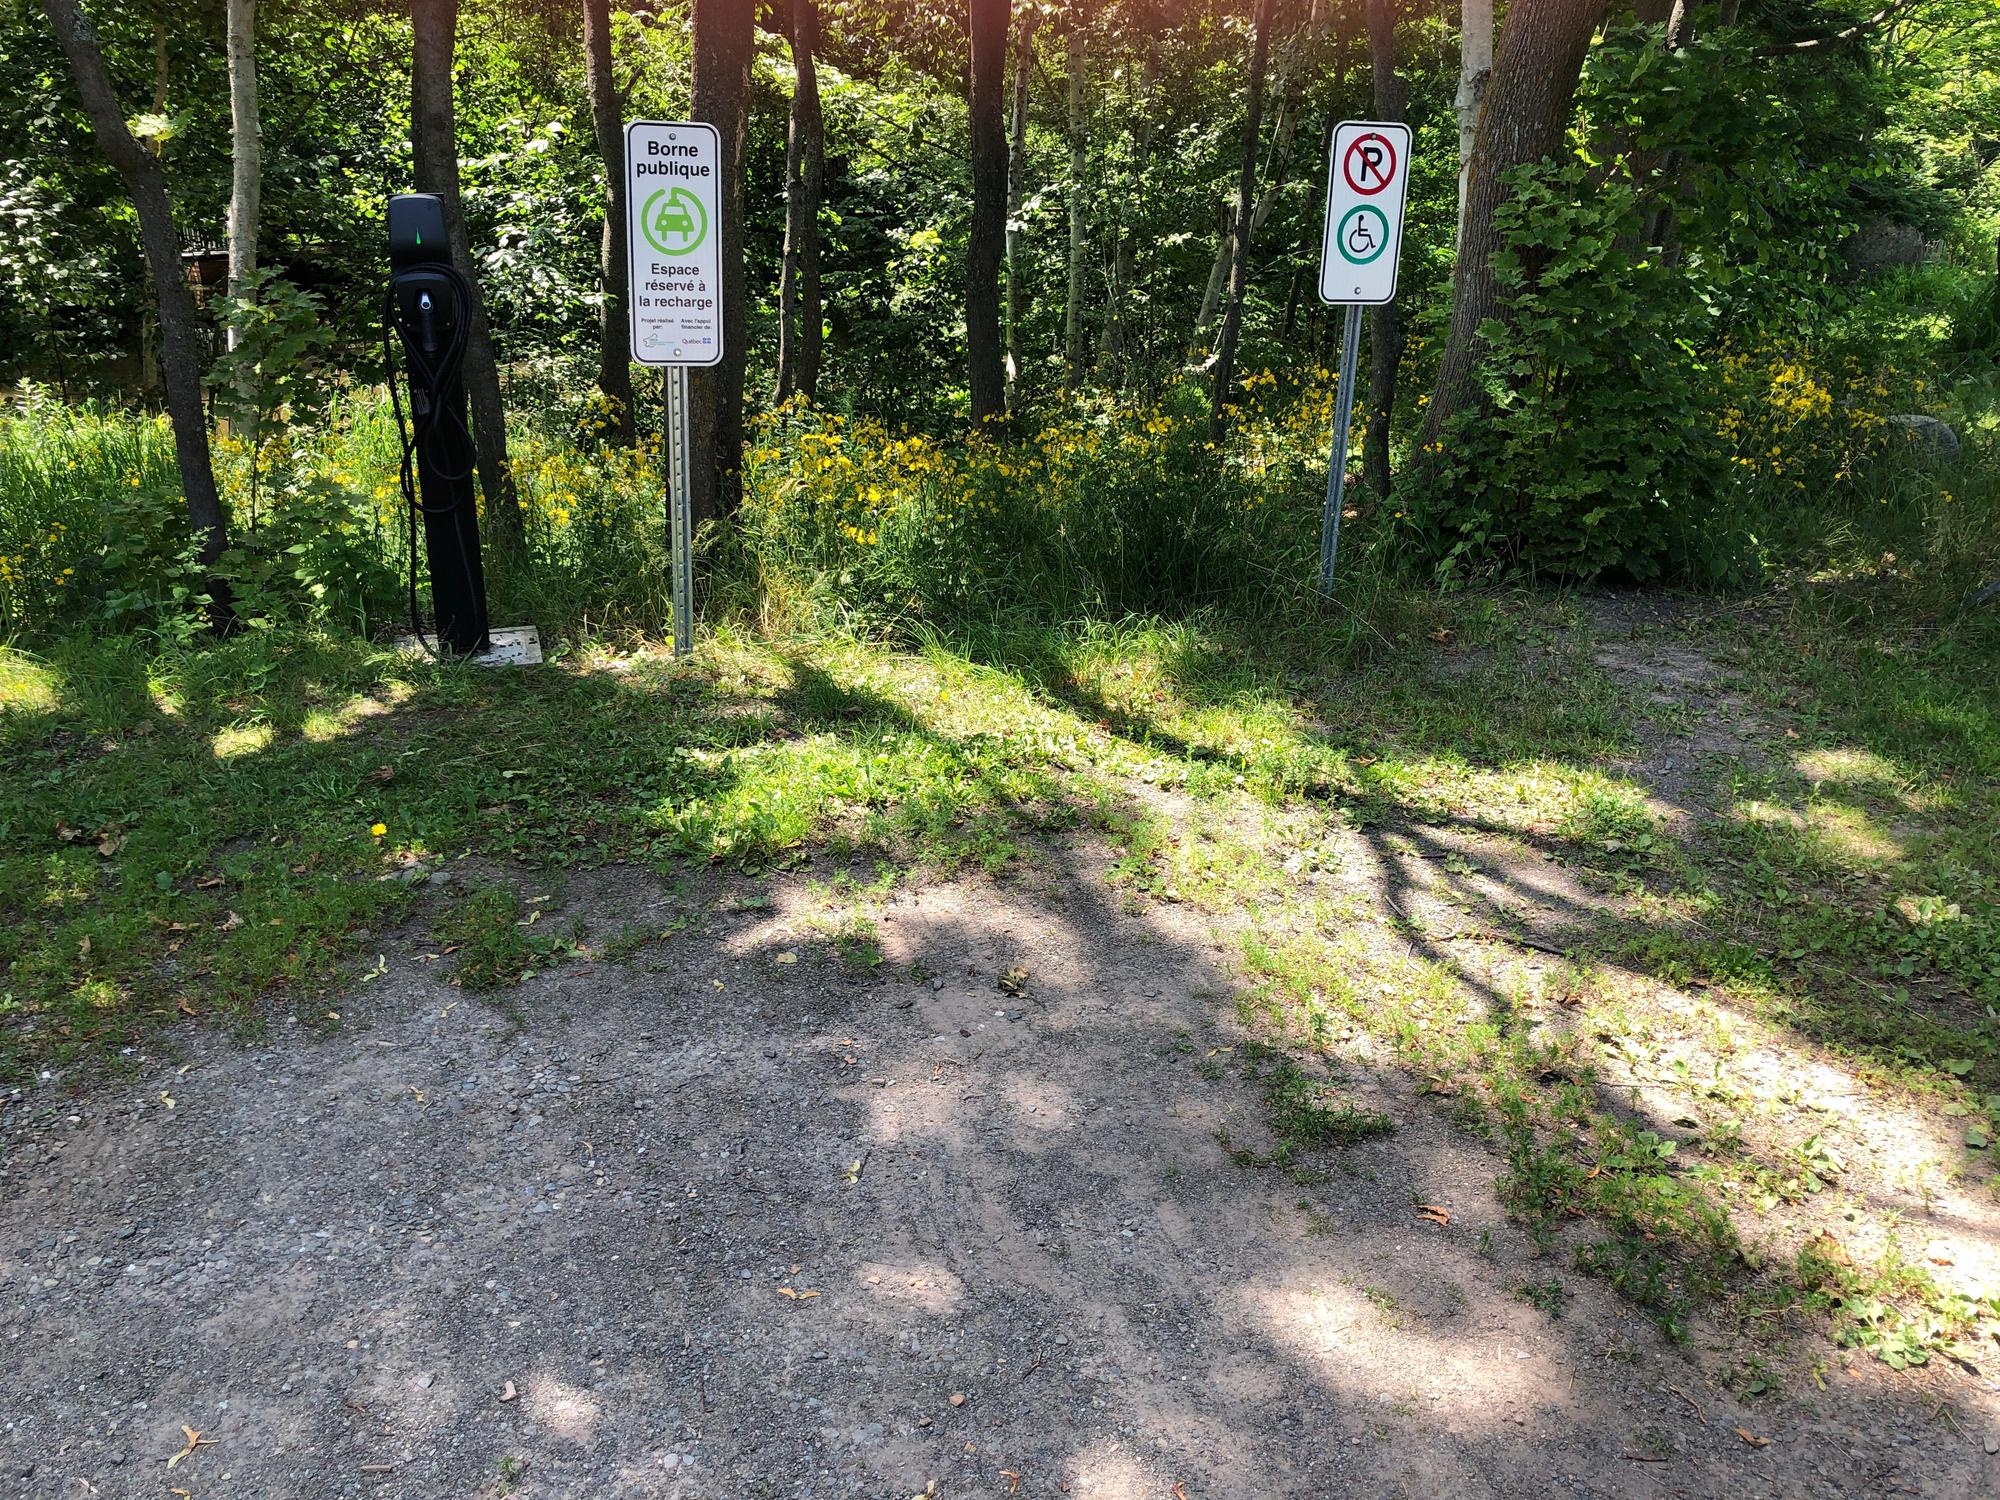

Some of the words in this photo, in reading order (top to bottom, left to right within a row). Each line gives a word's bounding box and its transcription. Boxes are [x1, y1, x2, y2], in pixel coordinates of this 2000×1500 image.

[648, 141, 698, 157] Borne
[637, 161, 710, 180] publique
[651, 263, 700, 277] Espace
[645, 279, 695, 291] réservé
[698, 280, 706, 292] à
[639, 295, 650, 307] la
[655, 296, 713, 310] recharge
